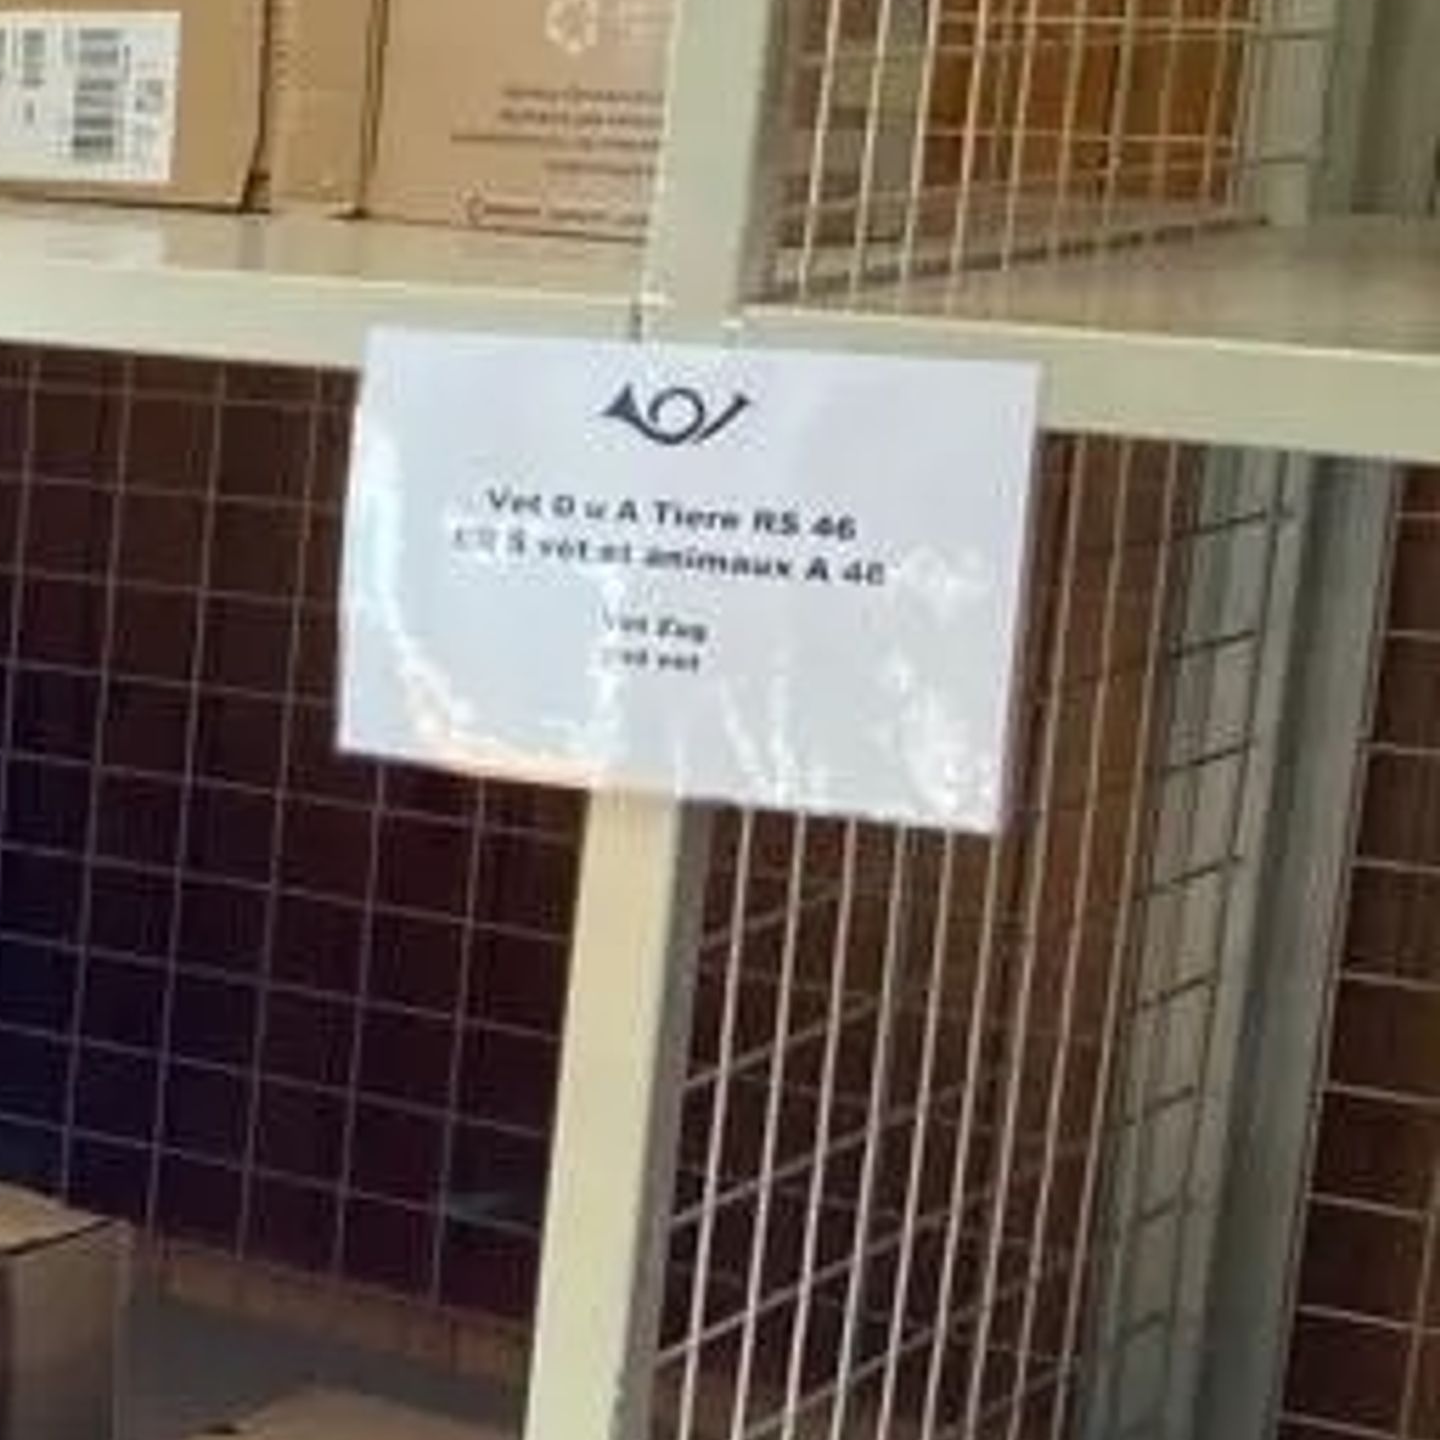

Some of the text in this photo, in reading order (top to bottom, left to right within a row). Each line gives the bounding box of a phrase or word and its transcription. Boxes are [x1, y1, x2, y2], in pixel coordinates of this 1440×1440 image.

[486, 487, 542, 514] Vet
[617, 499, 638, 523] A
[653, 499, 739, 532] Tiere
[753, 511, 800, 536] RS
[811, 515, 857, 541] 46
[805, 557, 829, 583] A
